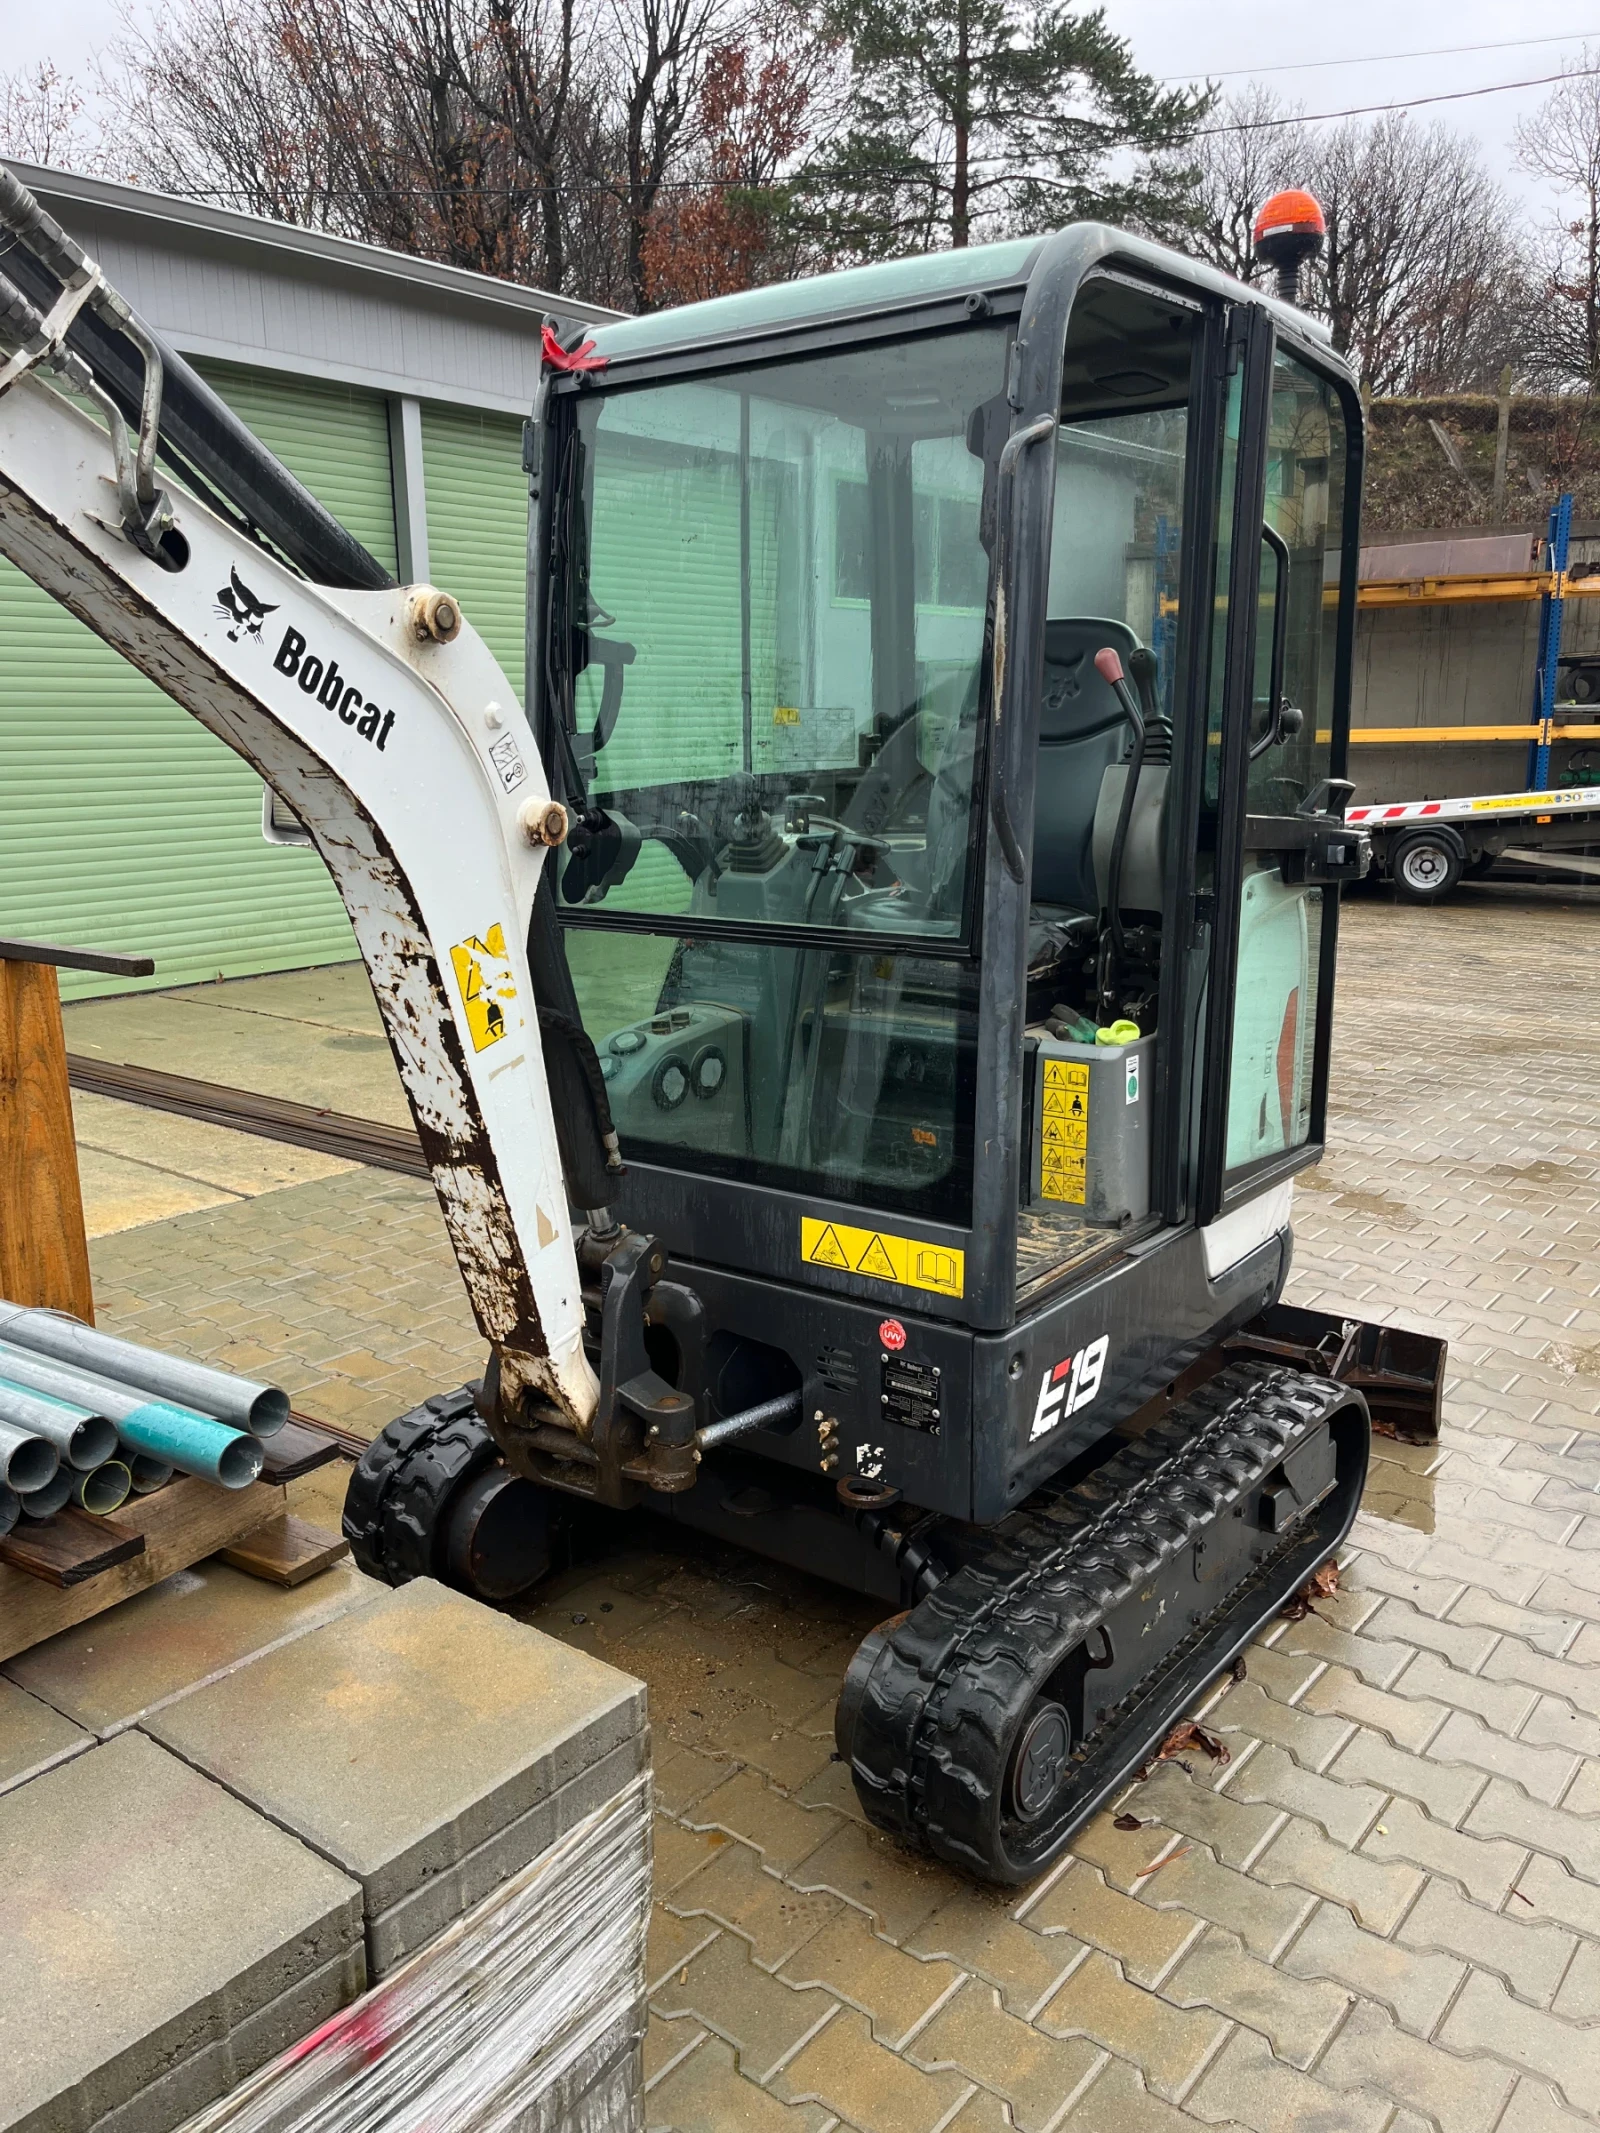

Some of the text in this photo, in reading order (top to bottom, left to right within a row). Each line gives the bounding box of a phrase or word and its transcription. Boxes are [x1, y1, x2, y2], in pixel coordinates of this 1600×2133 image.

[273, 625, 396, 752] Bobcat
[884, 1329, 901, 1343] UVV
[1029, 1333, 1110, 1442] E19
